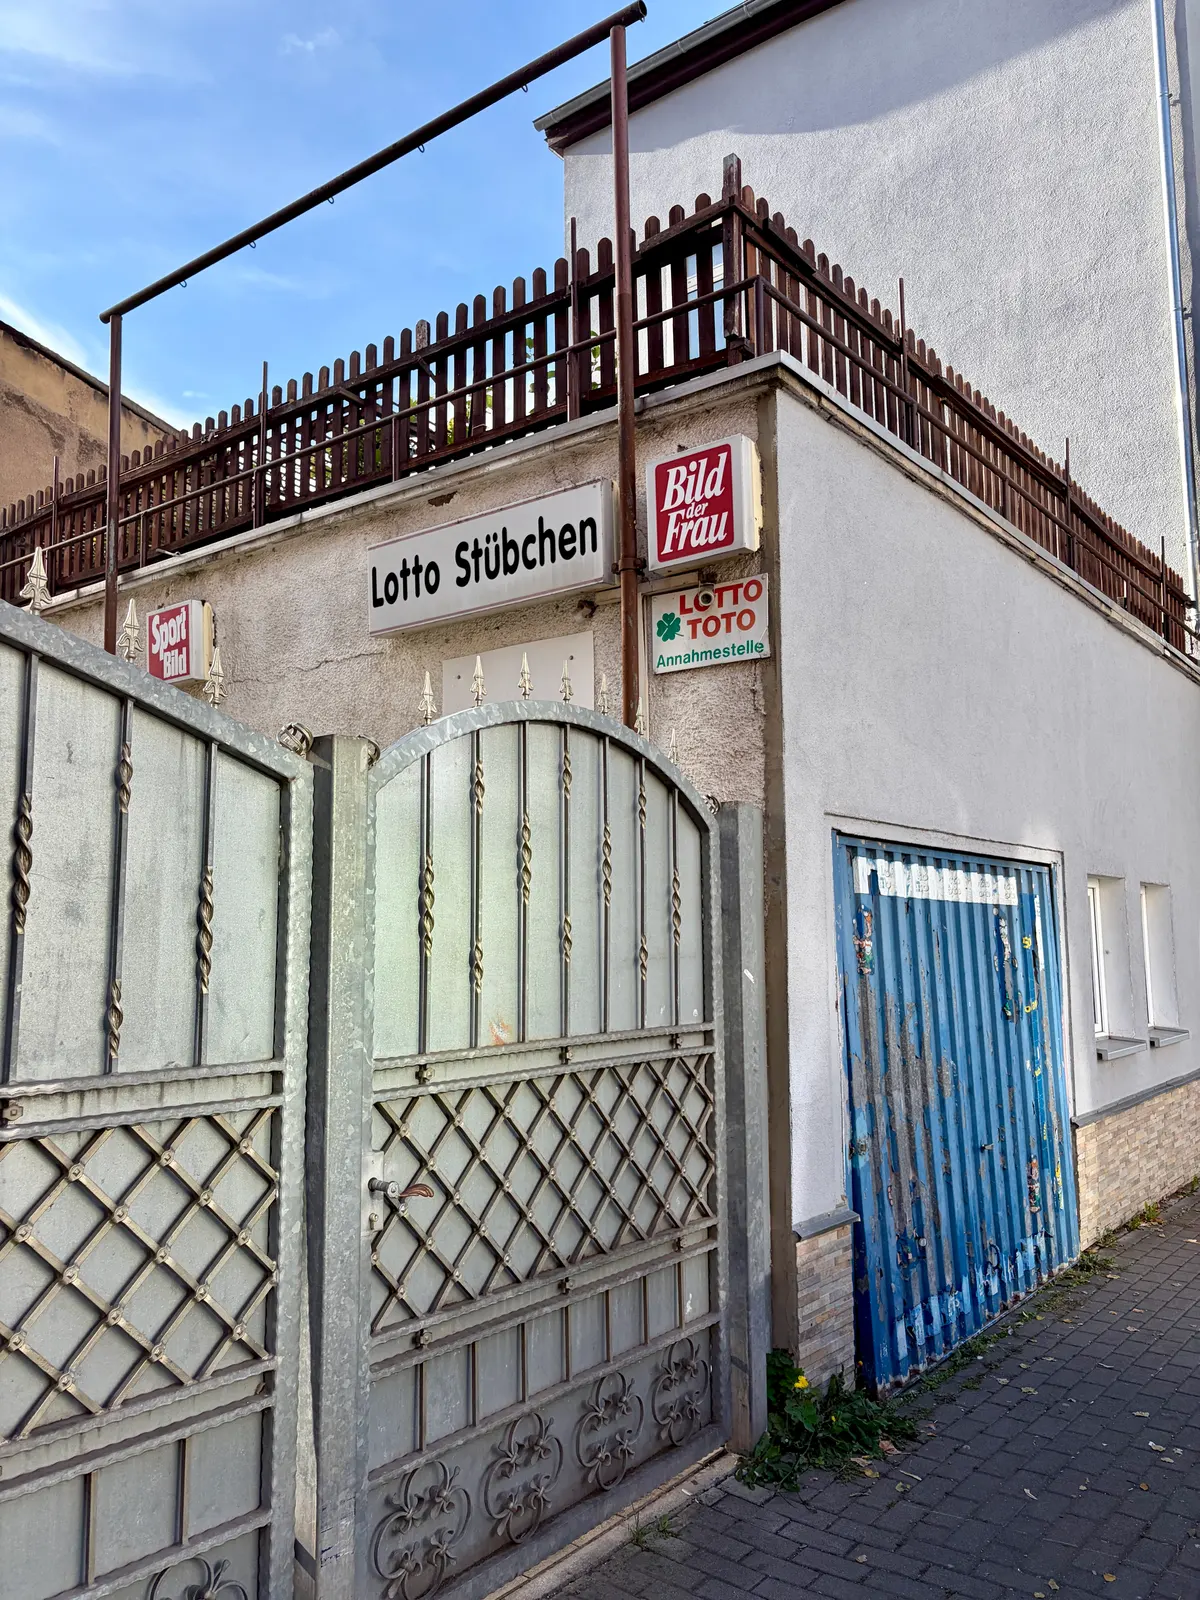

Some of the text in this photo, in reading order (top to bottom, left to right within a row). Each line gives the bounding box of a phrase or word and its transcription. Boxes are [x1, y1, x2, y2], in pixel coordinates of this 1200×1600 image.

[660, 451, 728, 512] Bild
[686, 502, 709, 519] der
[660, 511, 729, 555] Frau
[371, 516, 598, 608] Lotto Stübchen
[151, 607, 186, 661] Sport
[686, 608, 756, 640] TOTO
[163, 647, 187, 678] Bild
[656, 640, 765, 669] Annahmestelle
